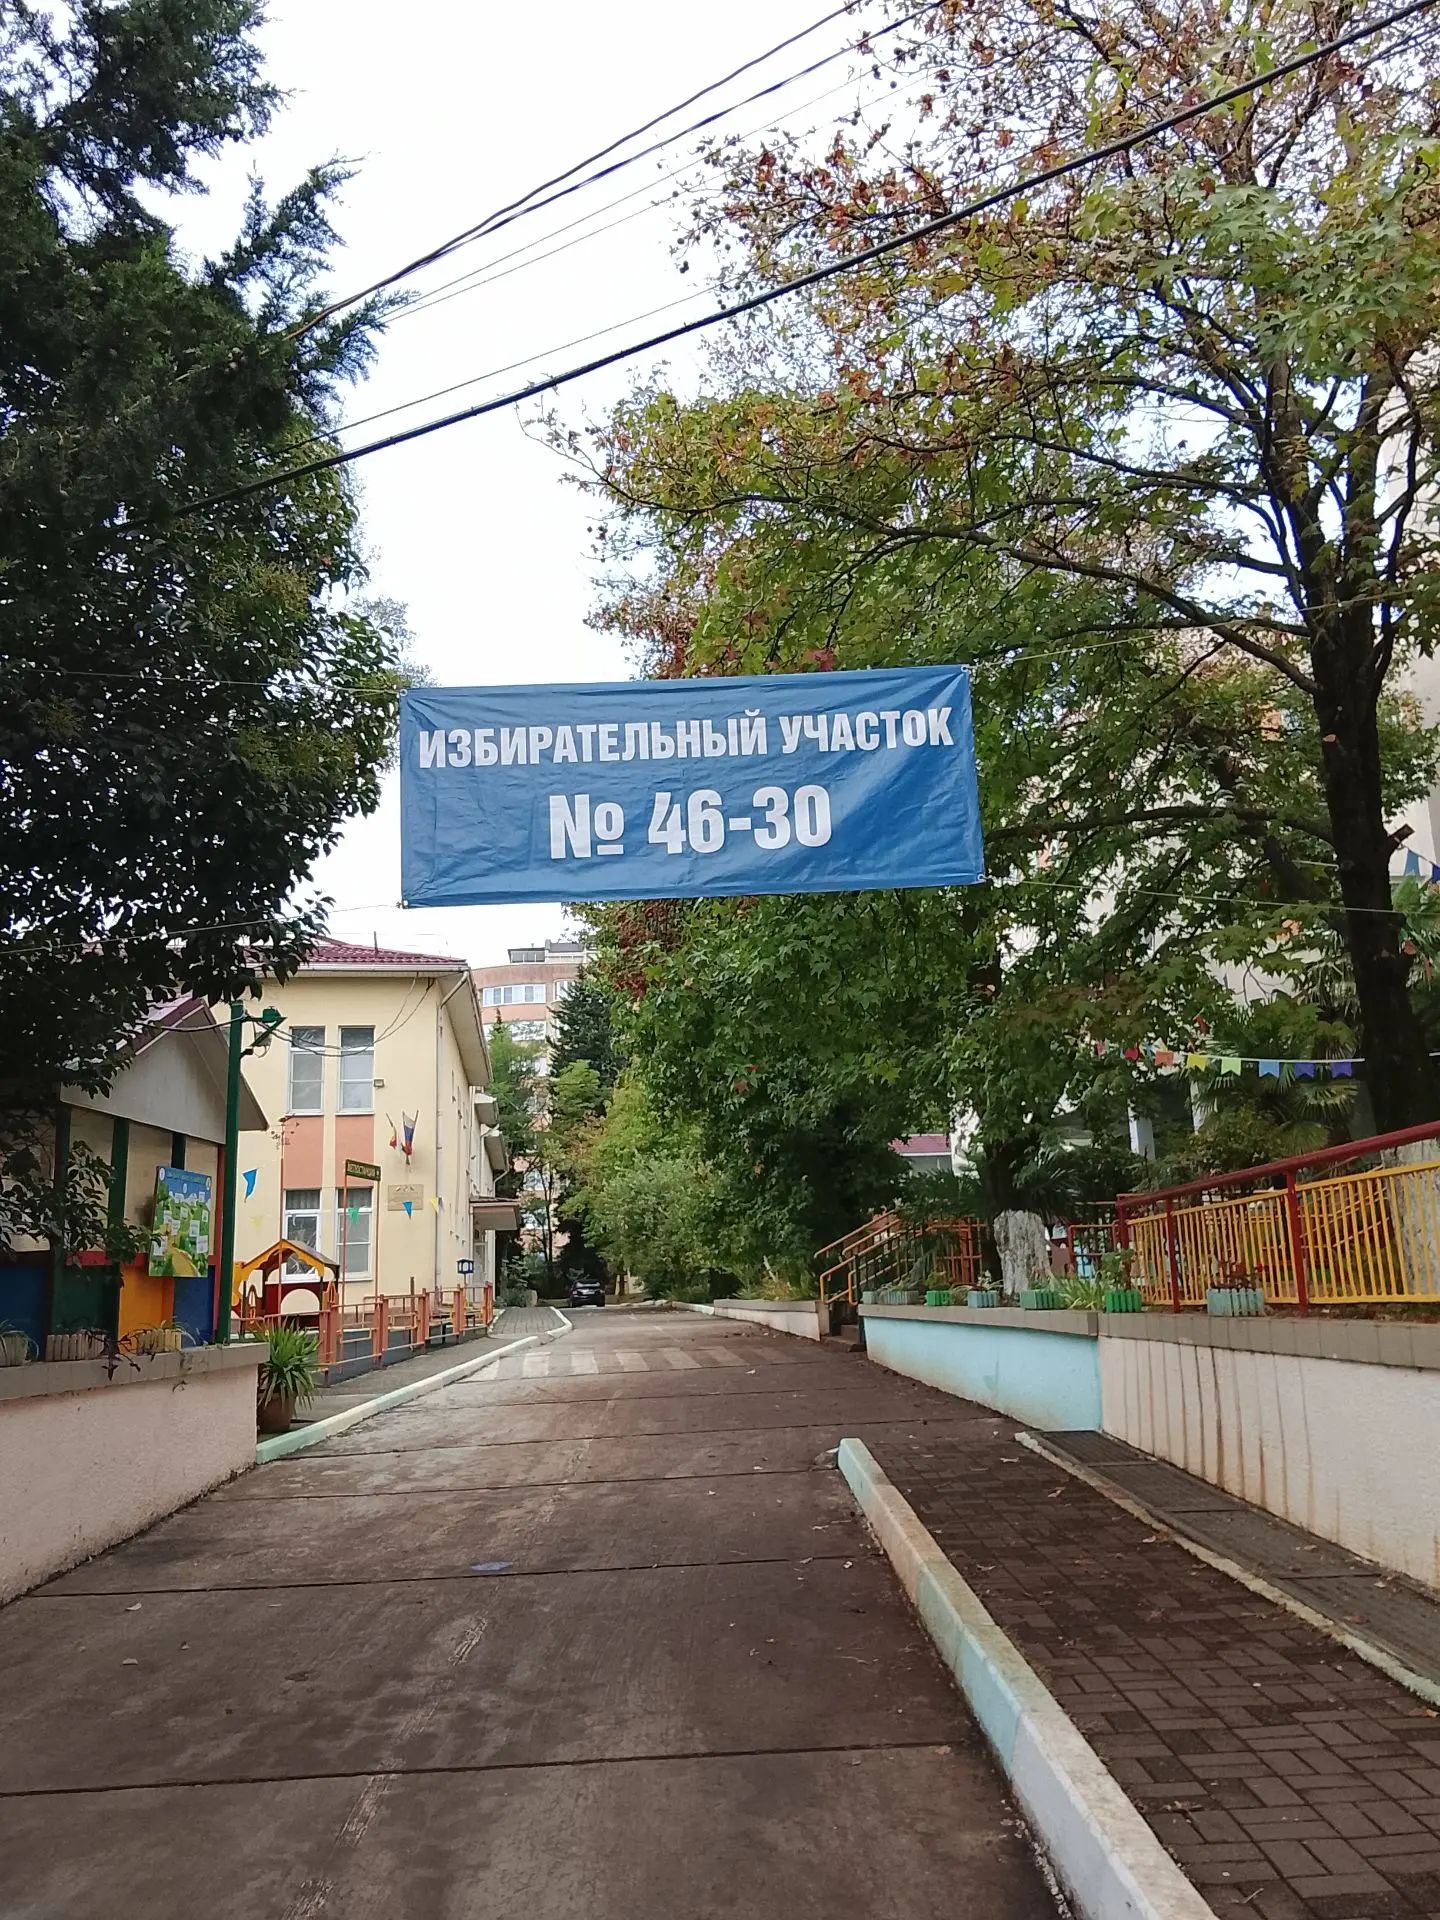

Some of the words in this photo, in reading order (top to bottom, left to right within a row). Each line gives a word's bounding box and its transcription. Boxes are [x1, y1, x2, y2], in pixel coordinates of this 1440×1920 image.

[418, 708, 768, 769] ИЗБИРАТЕЛЬНЫЙ
[779, 707, 955, 754] УЧАСТОК
[648, 784, 832, 854] 46-30
